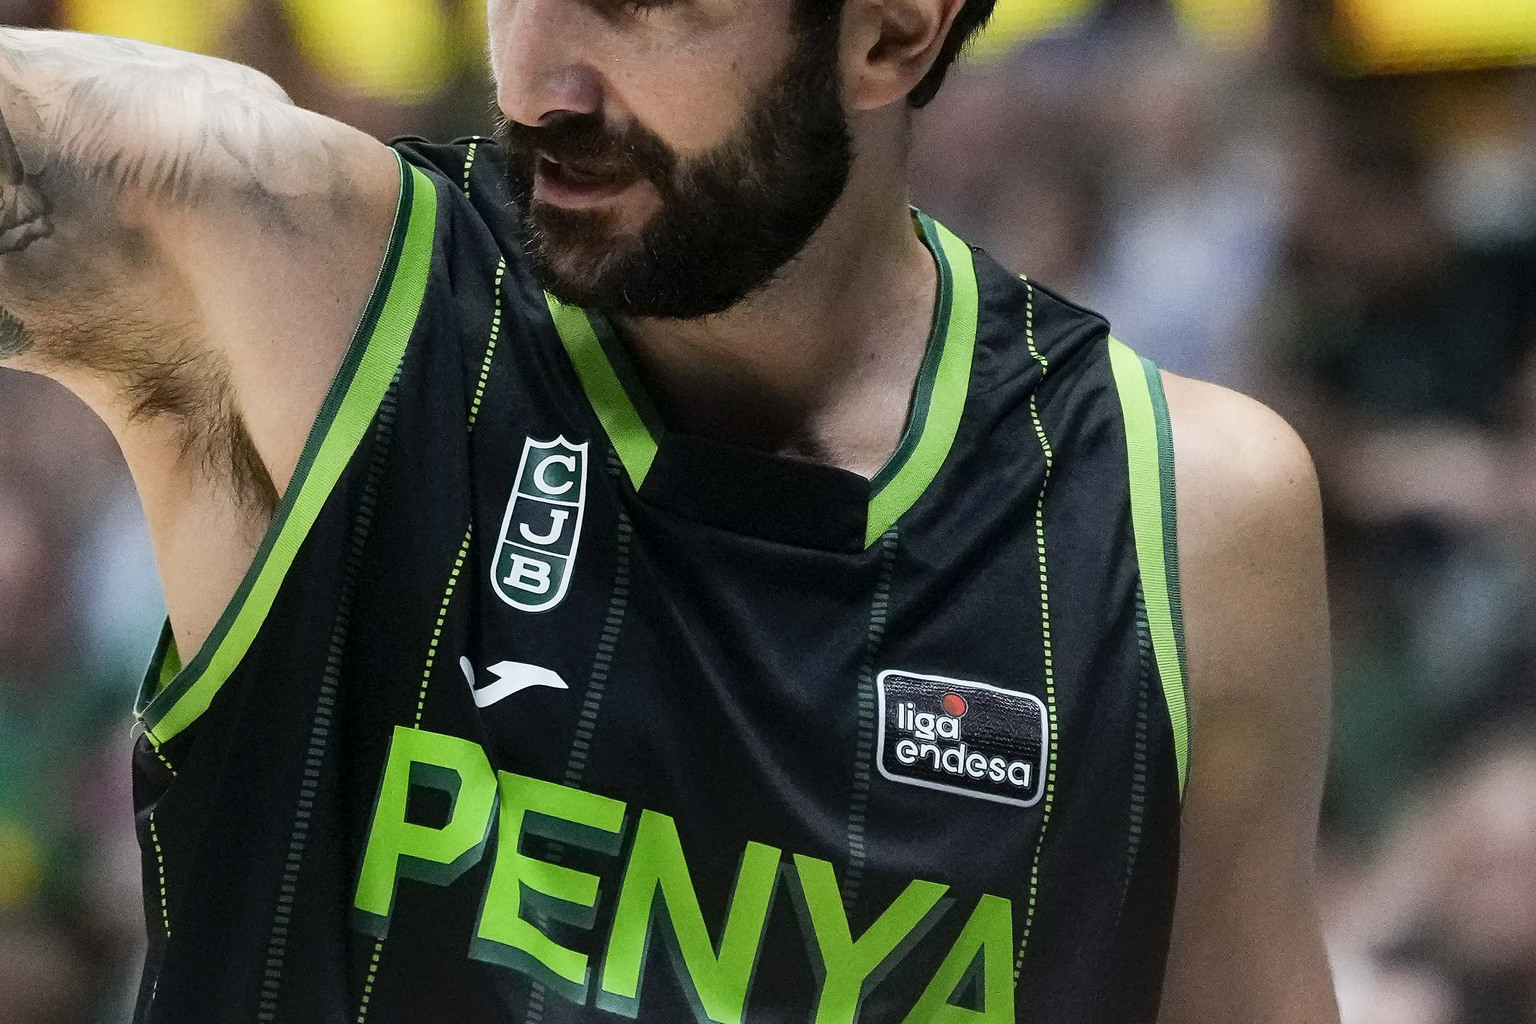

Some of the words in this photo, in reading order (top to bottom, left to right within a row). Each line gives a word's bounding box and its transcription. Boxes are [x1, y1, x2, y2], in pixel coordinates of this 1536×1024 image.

[502, 454, 576, 595] CJB
[895, 738, 1031, 787] endesa
[897, 702, 960, 741] liga
[353, 725, 1016, 1024] PENYA
